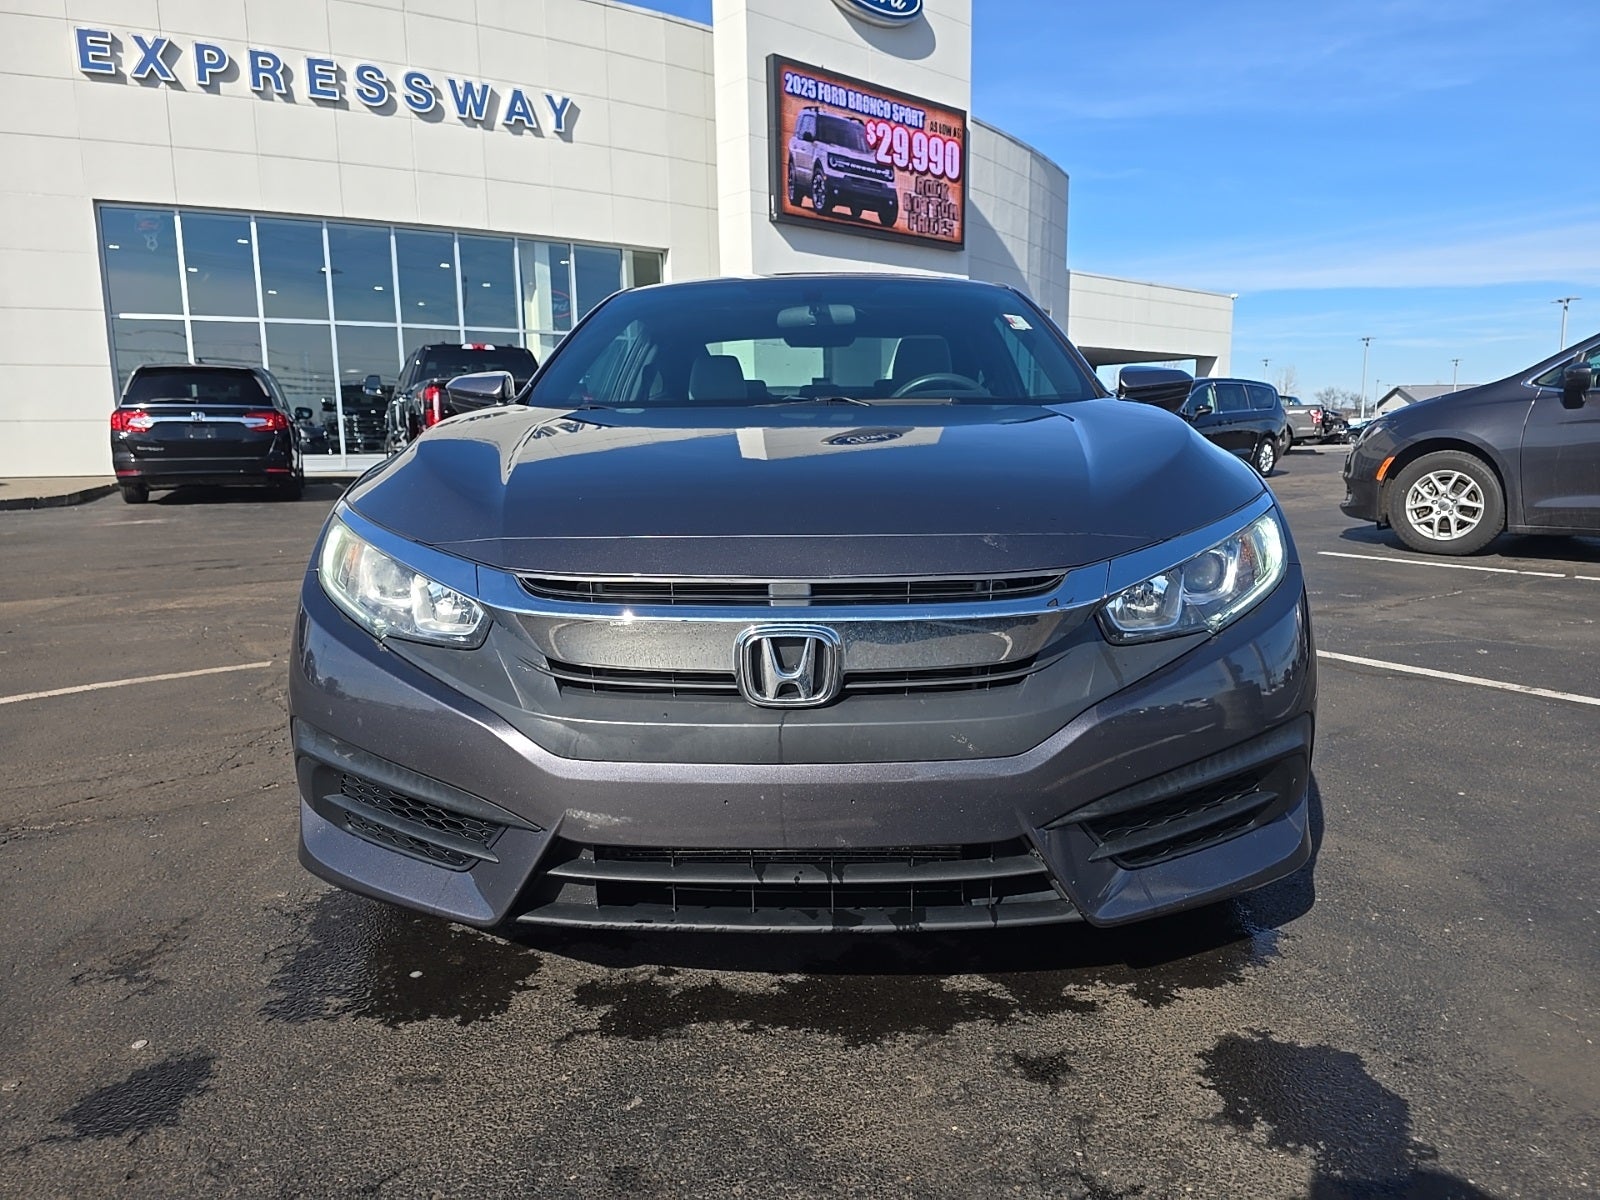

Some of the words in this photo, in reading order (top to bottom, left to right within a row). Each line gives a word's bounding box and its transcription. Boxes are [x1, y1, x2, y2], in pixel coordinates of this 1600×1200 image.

[75, 26, 574, 133] EXPRESSWAY
[785, 72, 816, 98] 2025
[818, 82, 846, 107] FORD
[848, 90, 891, 119] BRONCO
[892, 102, 925, 128] SPORT
[939, 123, 951, 137] LOW
[867, 120, 960, 179] $29,990
[915, 176, 949, 200] ROCK
[904, 192, 958, 220] BOTTOM
[908, 211, 955, 238] PRICES
